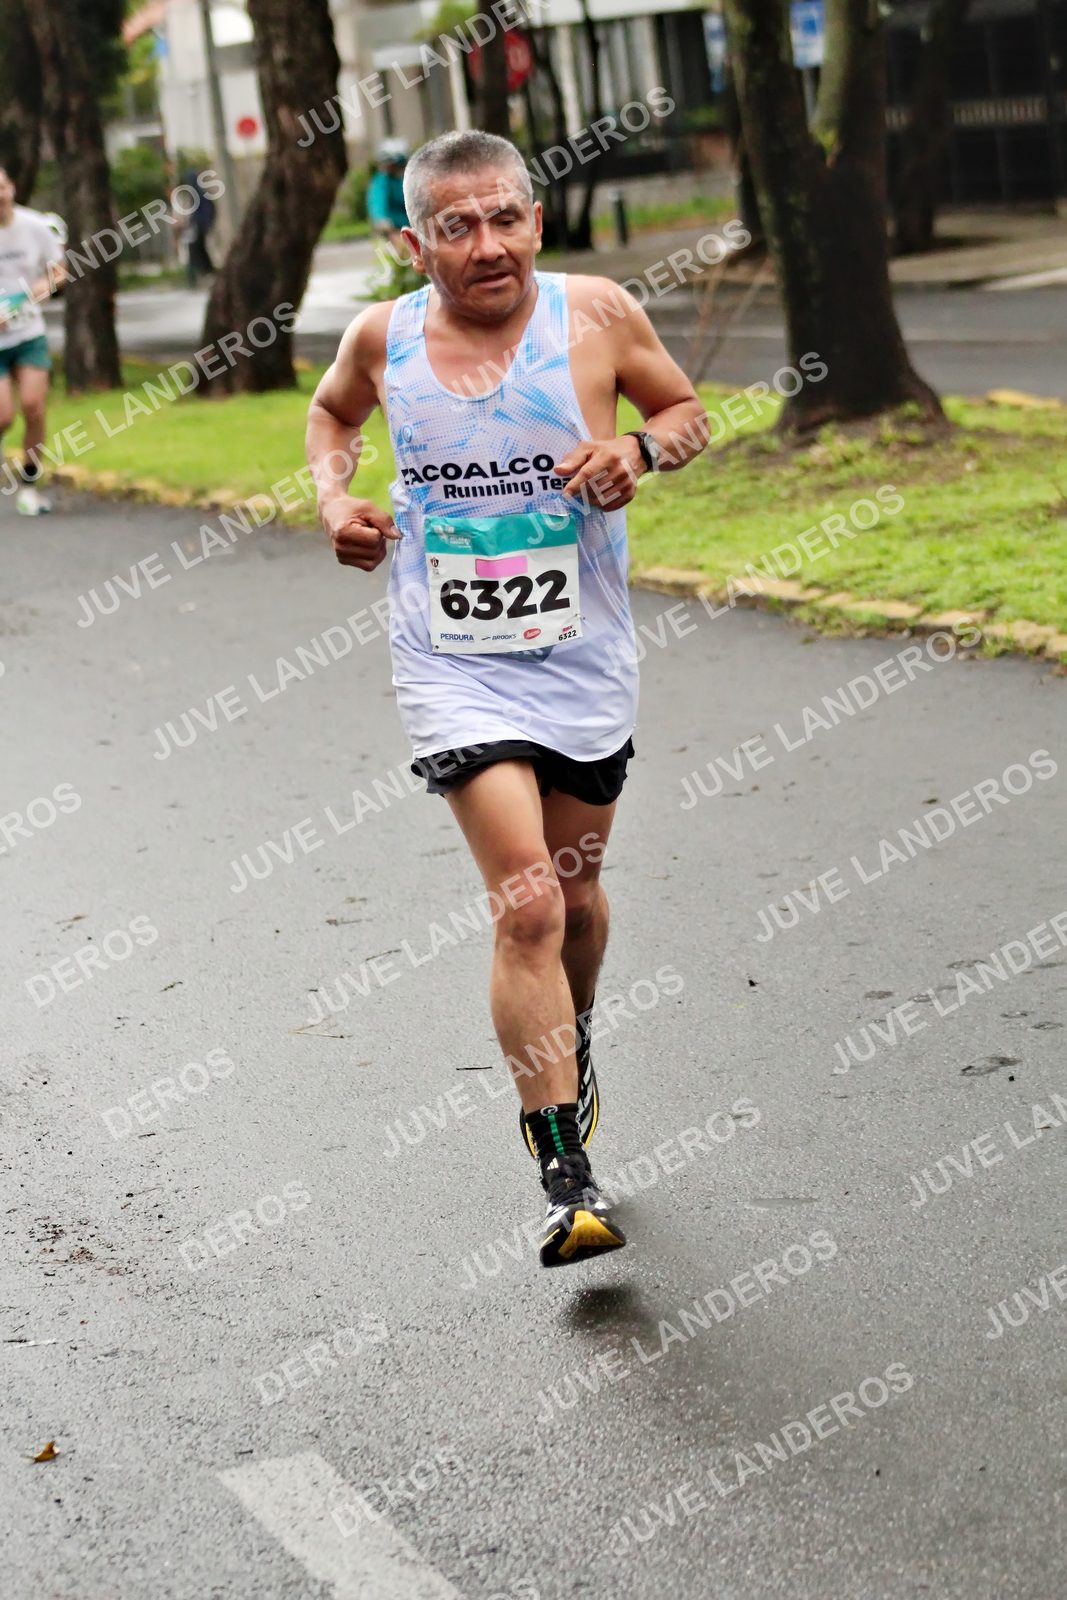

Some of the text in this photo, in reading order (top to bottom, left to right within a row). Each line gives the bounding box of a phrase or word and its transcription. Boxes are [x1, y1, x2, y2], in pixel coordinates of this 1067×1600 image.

[443, 480, 533, 499] Running
[440, 570, 570, 620] 6322
[440, 633, 474, 641] PERDURA
[558, 630, 577, 641] 6322
